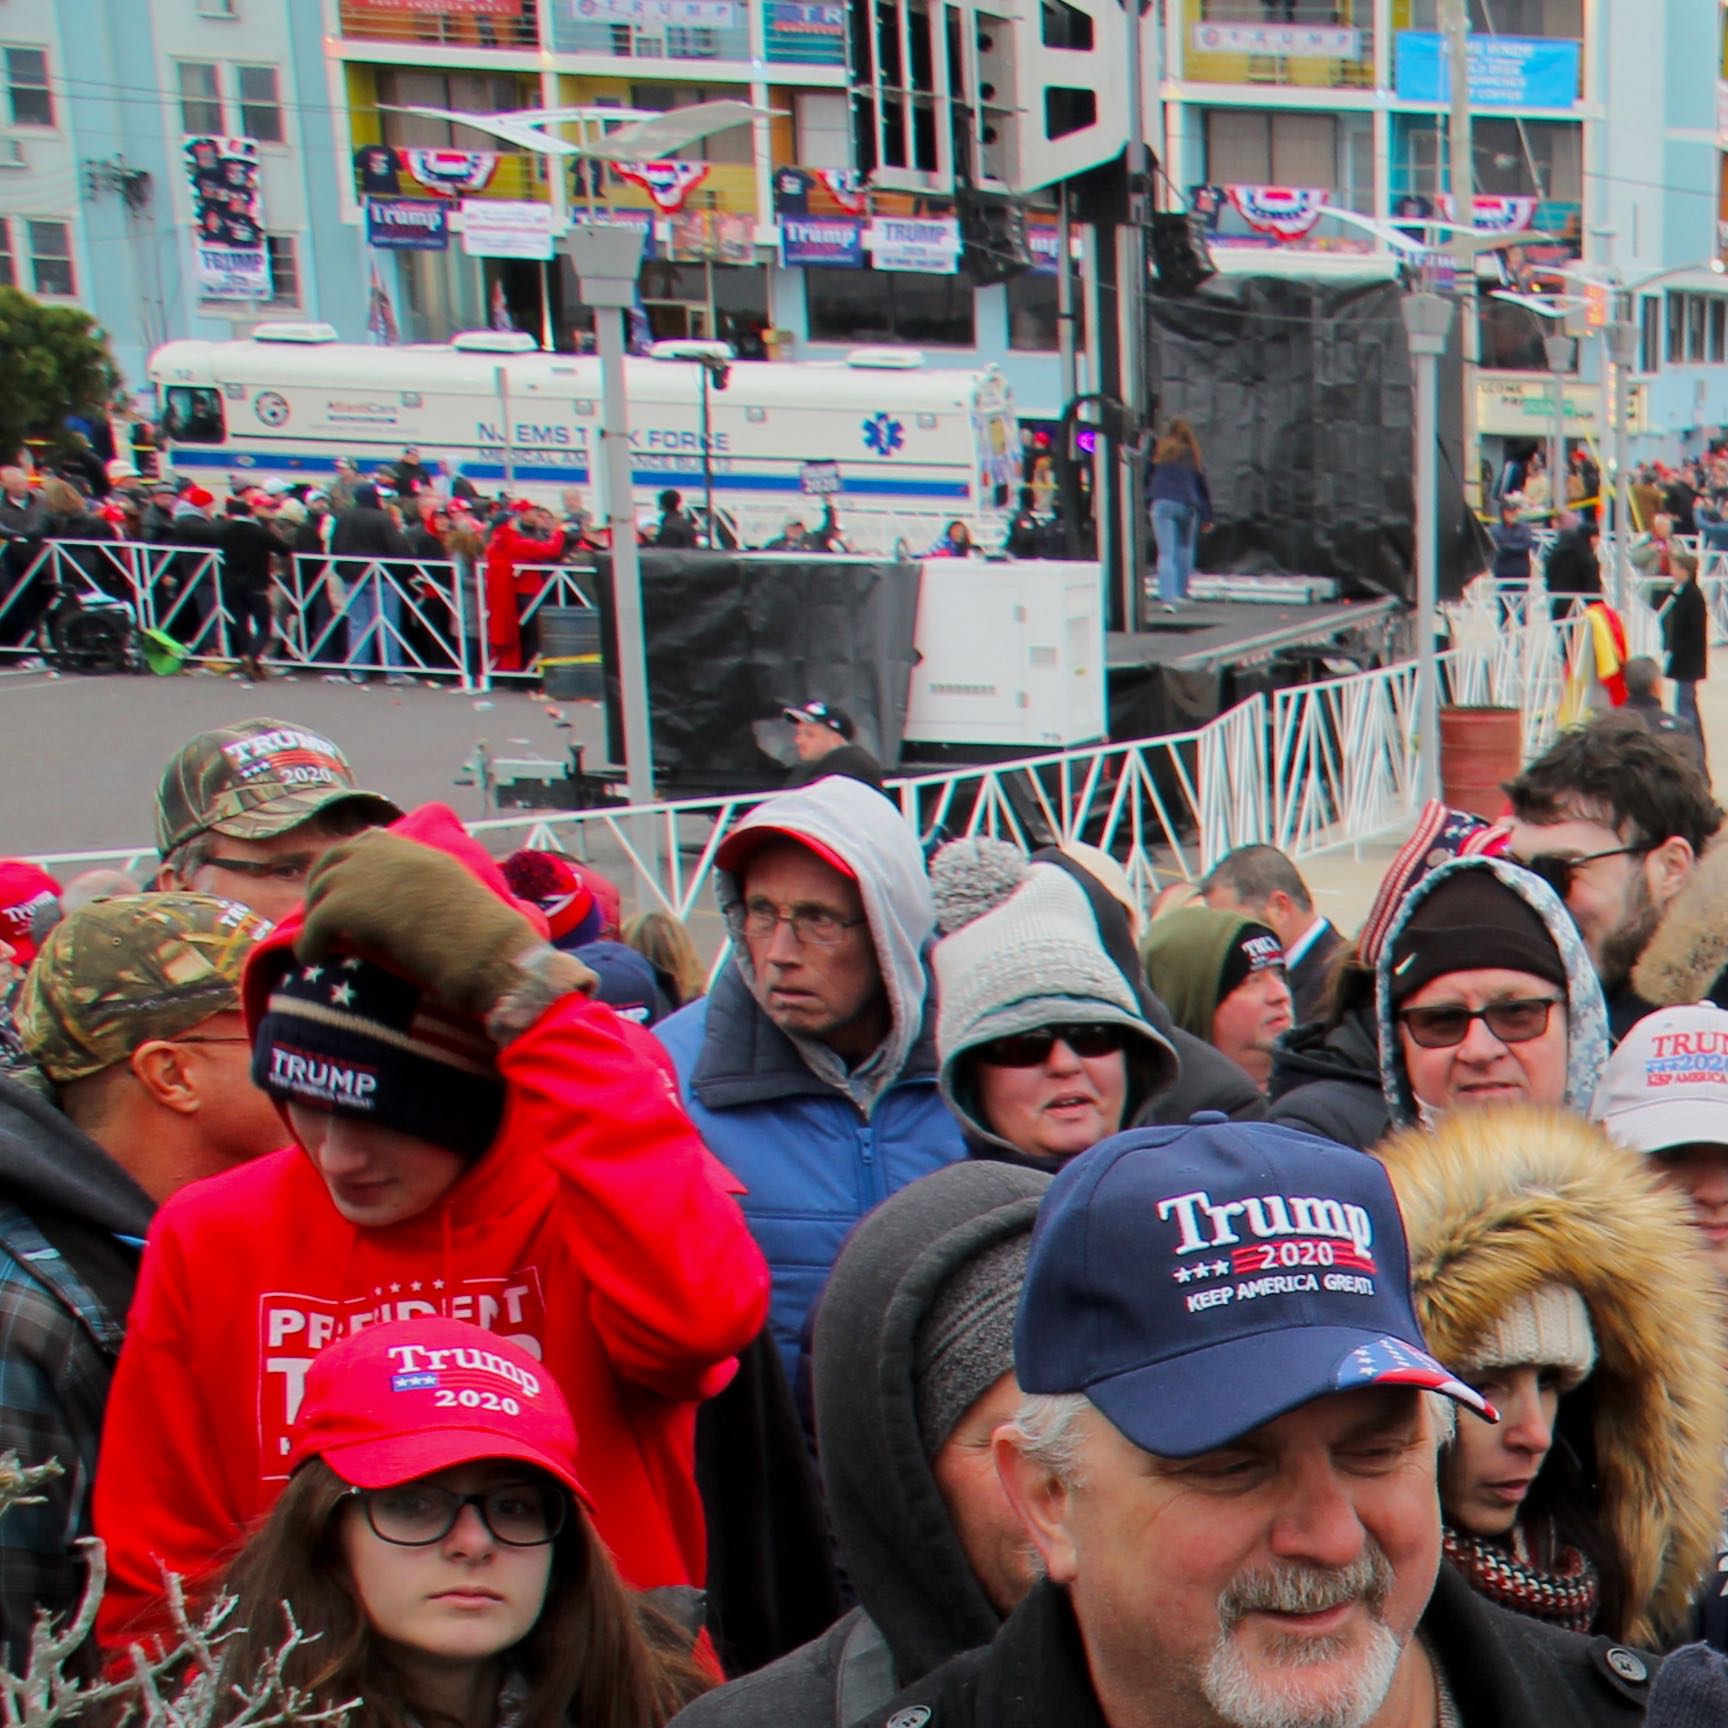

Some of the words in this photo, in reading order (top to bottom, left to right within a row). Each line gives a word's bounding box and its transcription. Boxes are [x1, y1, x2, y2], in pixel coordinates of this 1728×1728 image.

[370, 202, 443, 231] Trump
[785, 221, 858, 248] Trump
[883, 223, 947, 245] TRUMP
[517, 424, 570, 445] EMS
[575, 427, 641, 447] TK
[222, 727, 338, 760] TRUMP
[280, 767, 332, 785] 2020
[271, 1047, 377, 1099] TRUMP
[1675, 1071, 1727, 1085] AMERICA
[1158, 1192, 1374, 1260] Trump
[1259, 1242, 1335, 1270] 2020
[1185, 1287, 1236, 1314] KEEP
[1237, 1275, 1320, 1301] AMERICA
[1322, 1272, 1375, 1298] GREAT!
[268, 1286, 530, 1348] PREIDENT
[388, 1344, 541, 1399] Trump
[433, 1389, 520, 1416] 2020
